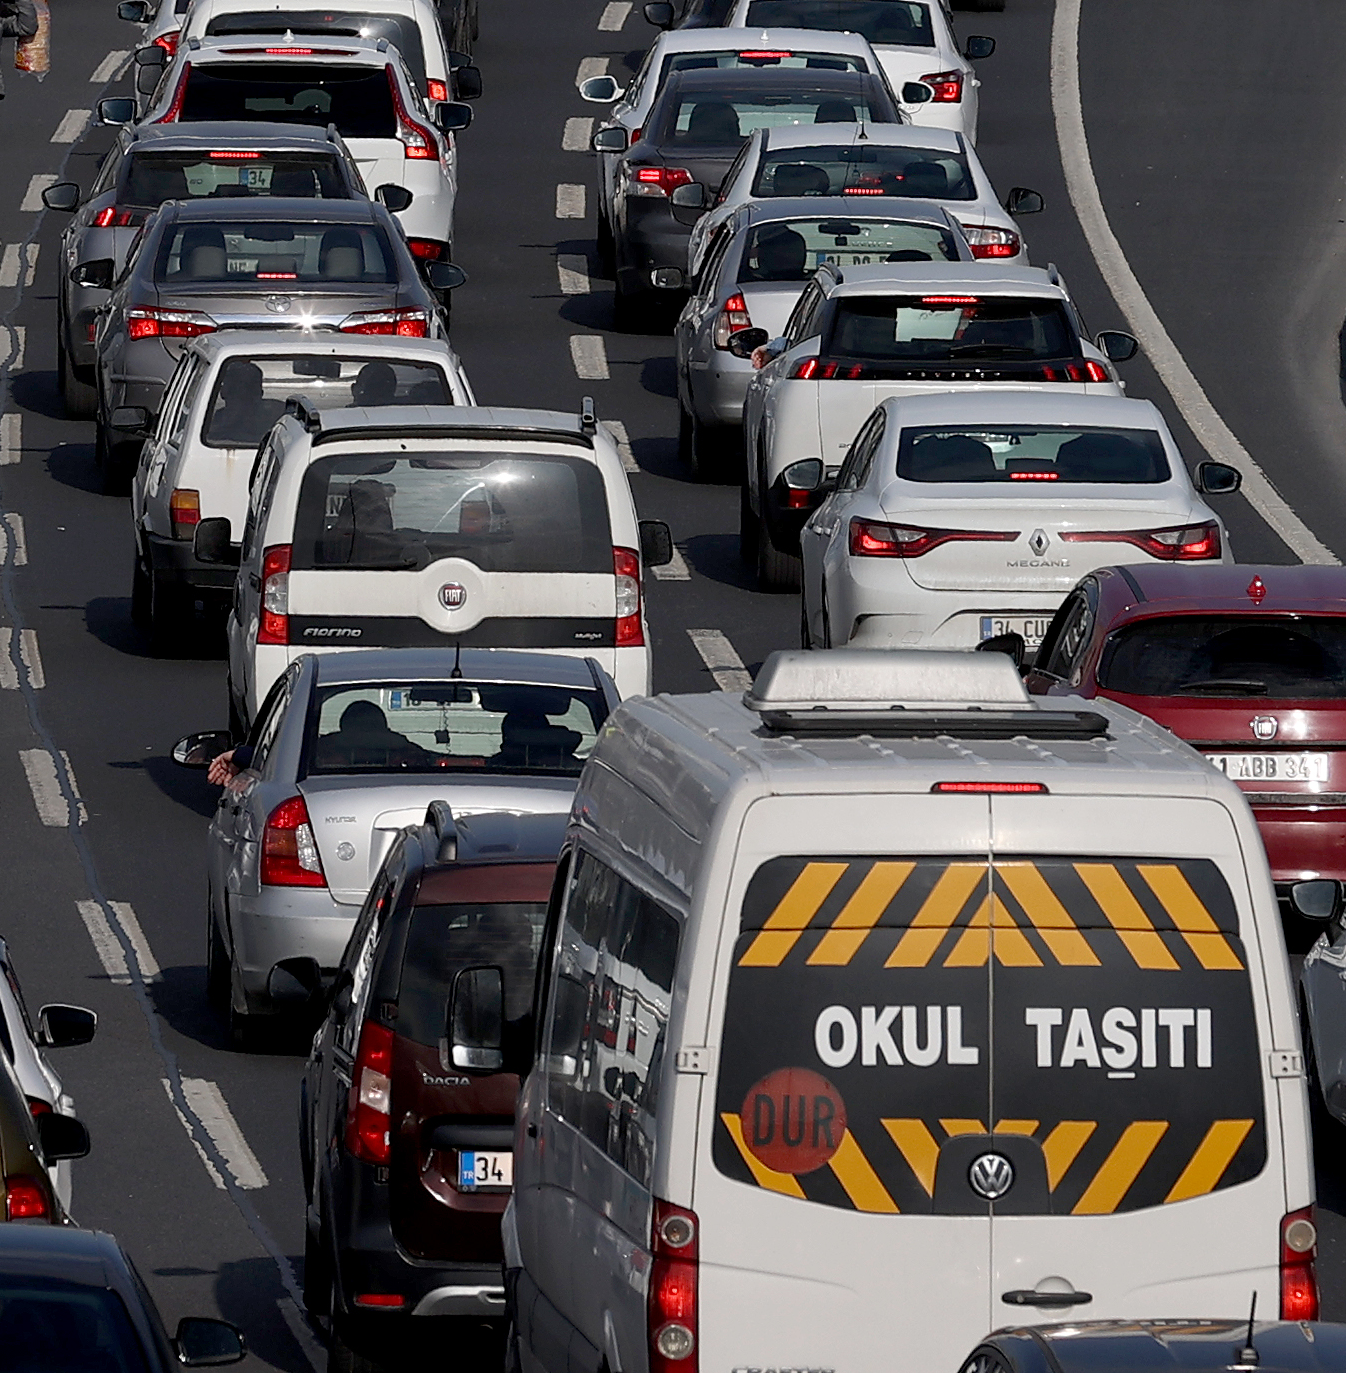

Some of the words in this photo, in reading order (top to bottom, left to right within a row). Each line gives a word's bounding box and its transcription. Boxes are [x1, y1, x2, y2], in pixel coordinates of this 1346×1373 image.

[248, 170, 266, 186] 34
[1006, 560, 1071, 568] MEGANE
[444, 589, 462, 603] FIAT
[994, 621, 1016, 637] 34
[1238, 756, 1276, 778] ABB
[815, 1005, 980, 1068] OKUL
[423, 1076, 471, 1086] DACIA
[753, 1093, 836, 1148] DUR
[475, 1156, 504, 1182] 34
